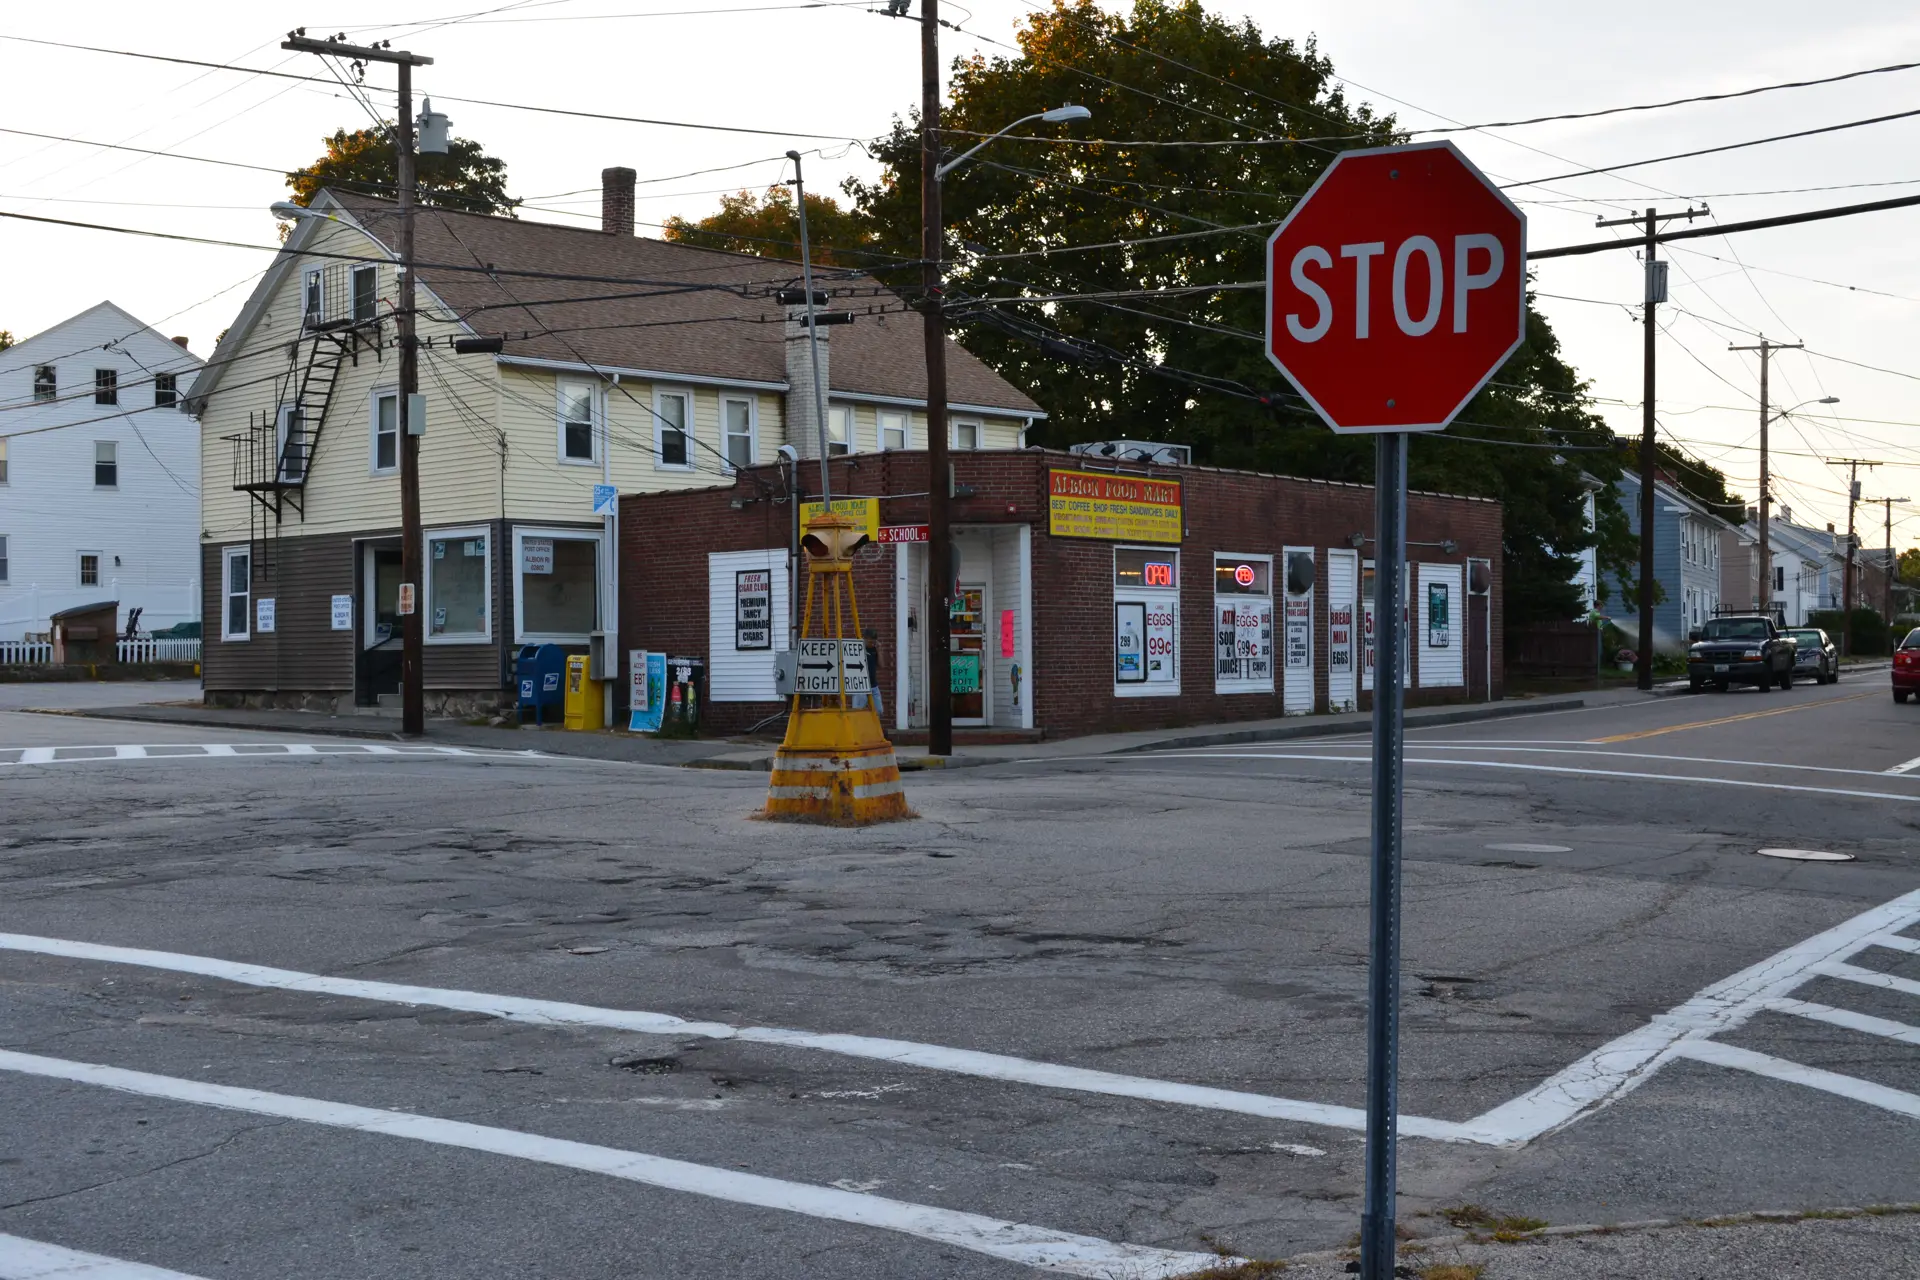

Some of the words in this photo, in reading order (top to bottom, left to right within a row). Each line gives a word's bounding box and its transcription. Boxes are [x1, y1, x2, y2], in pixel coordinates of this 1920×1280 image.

[1286, 232, 1505, 343] STOP
[1053, 476, 1099, 497] ALBION
[1105, 480, 1137, 499] FOOD
[1143, 484, 1175, 503] MART
[1052, 499, 1066, 509] BEST
[1068, 500, 1091, 512] COFFEE
[1093, 502, 1109, 513] SHOP
[1109, 504, 1128, 515] FRESH
[1129, 505, 1163, 517] SANDWICHES
[1165, 509, 1178, 518] DAILY
[889, 528, 919, 541] SCHOOL
[744, 574, 762, 583] FRESH
[1146, 564, 1171, 585] OPEN
[738, 583, 753, 593] CIGAR
[754, 582, 768, 592] CLUB
[740, 597, 767, 608] PREMIUM
[743, 609, 762, 619] FANCY
[1147, 613, 1172, 627] EGGS
[1236, 615, 1259, 627] EGGS
[1331, 611, 1350, 625] BREAD
[738, 619, 769, 630] HANDMADE
[742, 631, 764, 642] CIGARS
[1219, 631, 1235, 646] SOD
[1332, 630, 1348, 644] MILK
[801, 642, 836, 656] KEEP
[843, 643, 863, 657] KEEP
[1226, 647, 1231, 658] &
[1332, 651, 1349, 665] EGGS
[1218, 659, 1239, 674] JUICE
[1252, 661, 1267, 672] CHIPS
[633, 673, 645, 685] EBT
[797, 676, 838, 690] RIGHT
[844, 676, 869, 690] RIGHT
